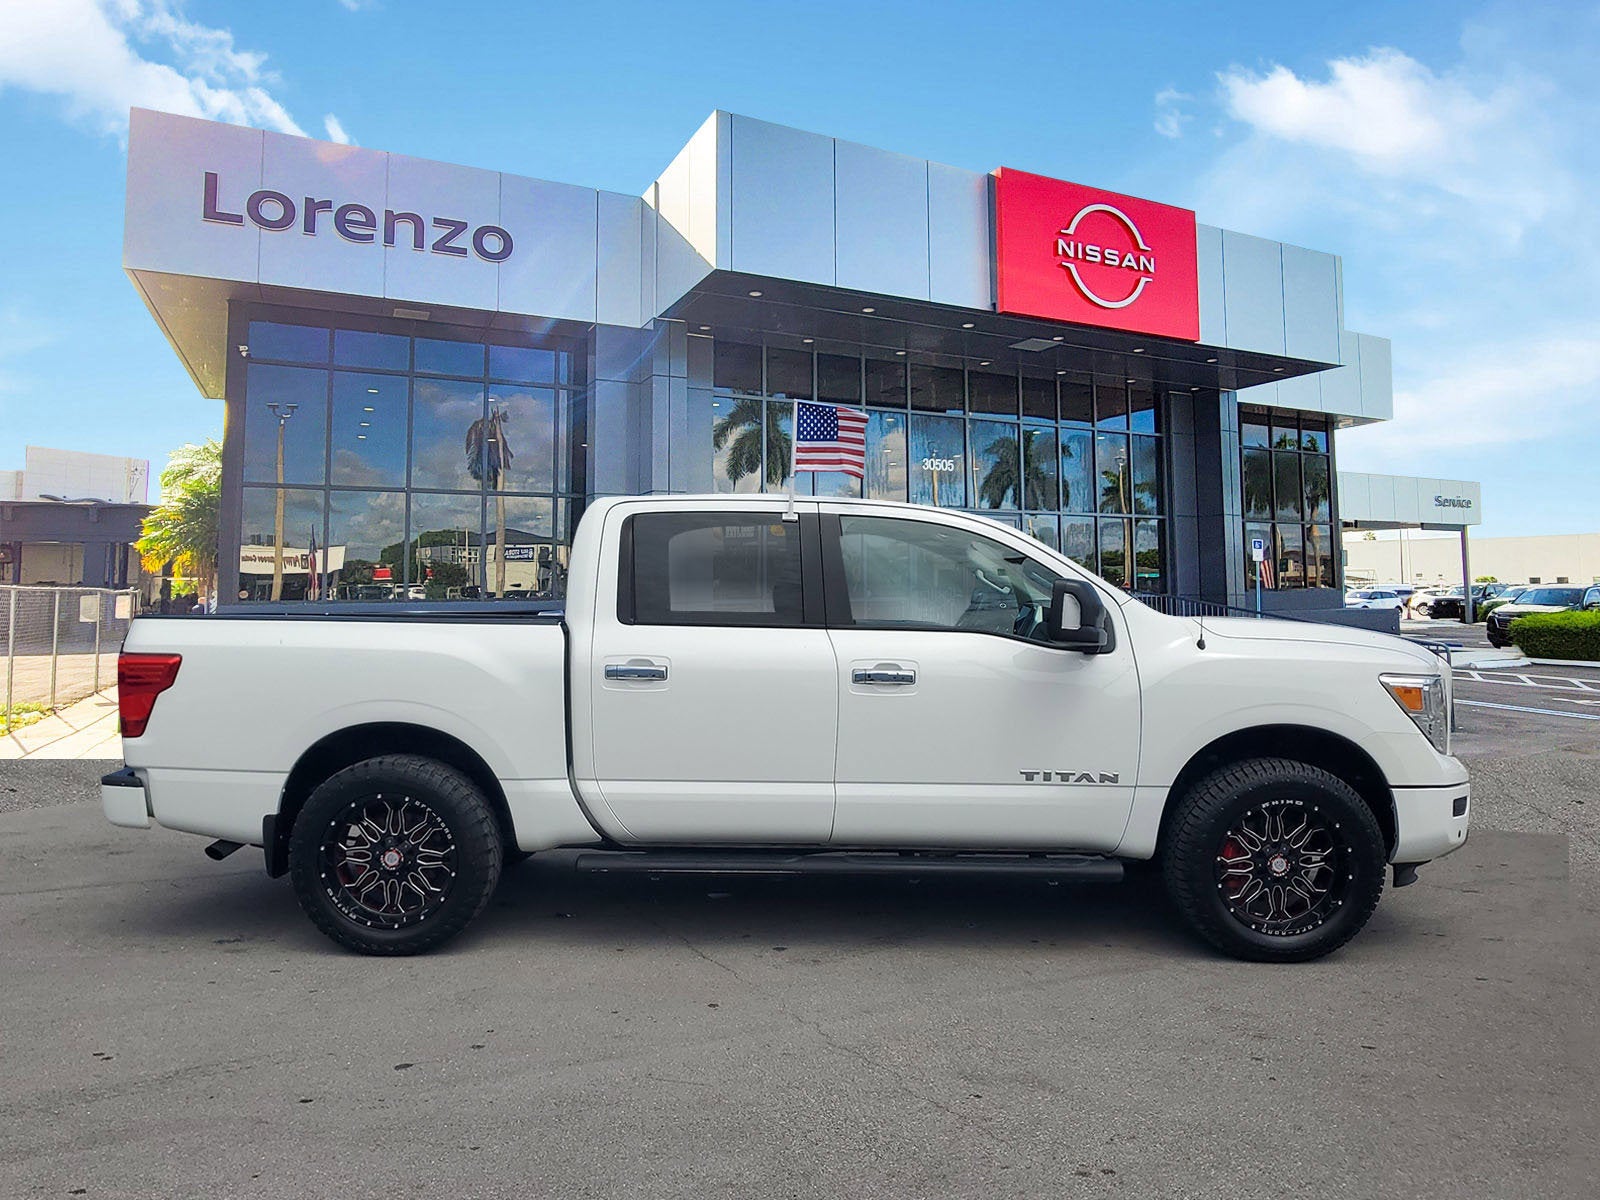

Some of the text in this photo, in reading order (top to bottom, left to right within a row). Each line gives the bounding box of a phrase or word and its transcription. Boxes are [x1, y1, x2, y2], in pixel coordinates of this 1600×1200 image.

[202, 171, 514, 262] Lorenzo
[1057, 238, 1155, 273] NISSAN
[922, 457, 955, 471] 30505
[1434, 495, 1472, 508] Service
[1019, 769, 1119, 784] TITAN
